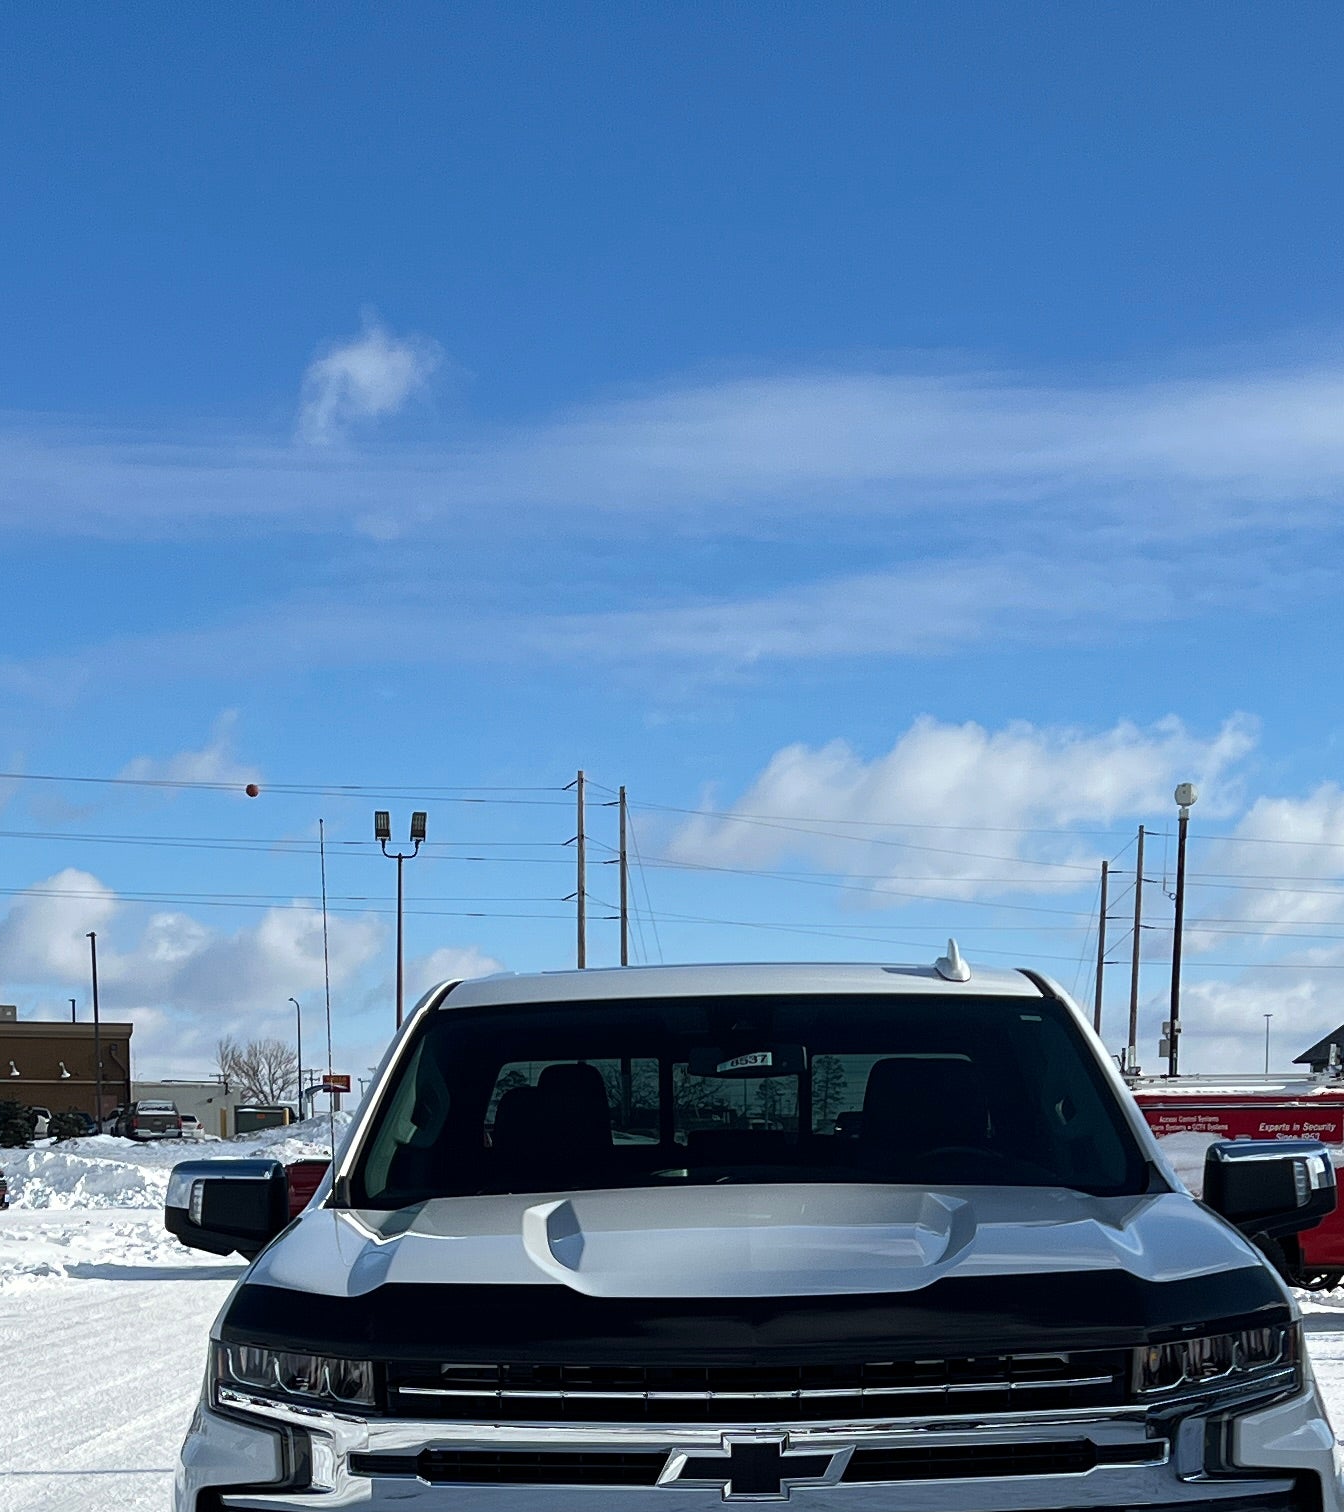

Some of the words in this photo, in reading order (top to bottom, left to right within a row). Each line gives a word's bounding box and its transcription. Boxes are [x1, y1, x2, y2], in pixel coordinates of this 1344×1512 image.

[1258, 1122, 1290, 1133] Experts
[1293, 1123, 1300, 1131] in
[1302, 1122, 1336, 1132] Security
